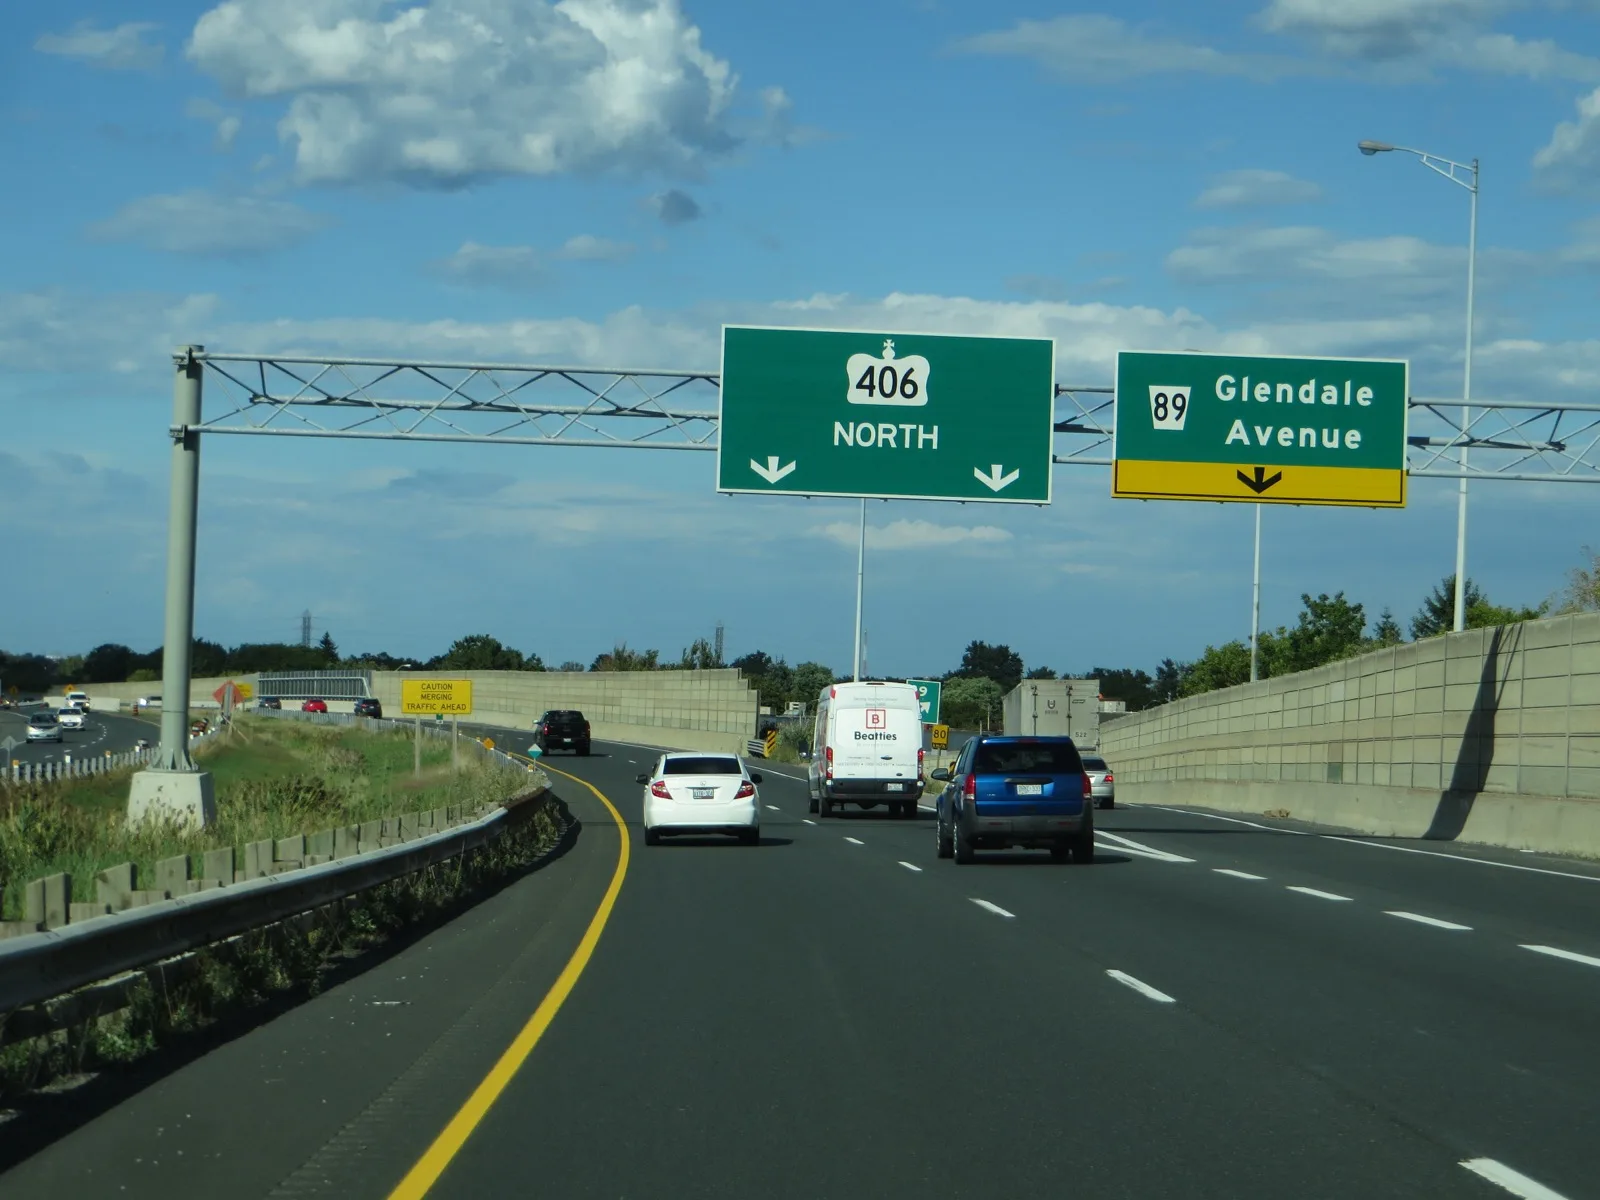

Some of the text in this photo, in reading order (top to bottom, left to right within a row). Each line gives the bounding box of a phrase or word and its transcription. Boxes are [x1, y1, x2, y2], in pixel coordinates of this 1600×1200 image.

[855, 365, 919, 399] 406
[1215, 374, 1374, 407] Glendale
[1153, 392, 1187, 422] 89
[833, 421, 939, 450] NORTH
[1224, 419, 1362, 450] Avenue
[420, 693, 453, 701] MERGING
[440, 703, 467, 711] AHEAD
[871, 714, 880, 724] B
[854, 731, 897, 741] Beatties
[933, 729, 947, 739] 80
